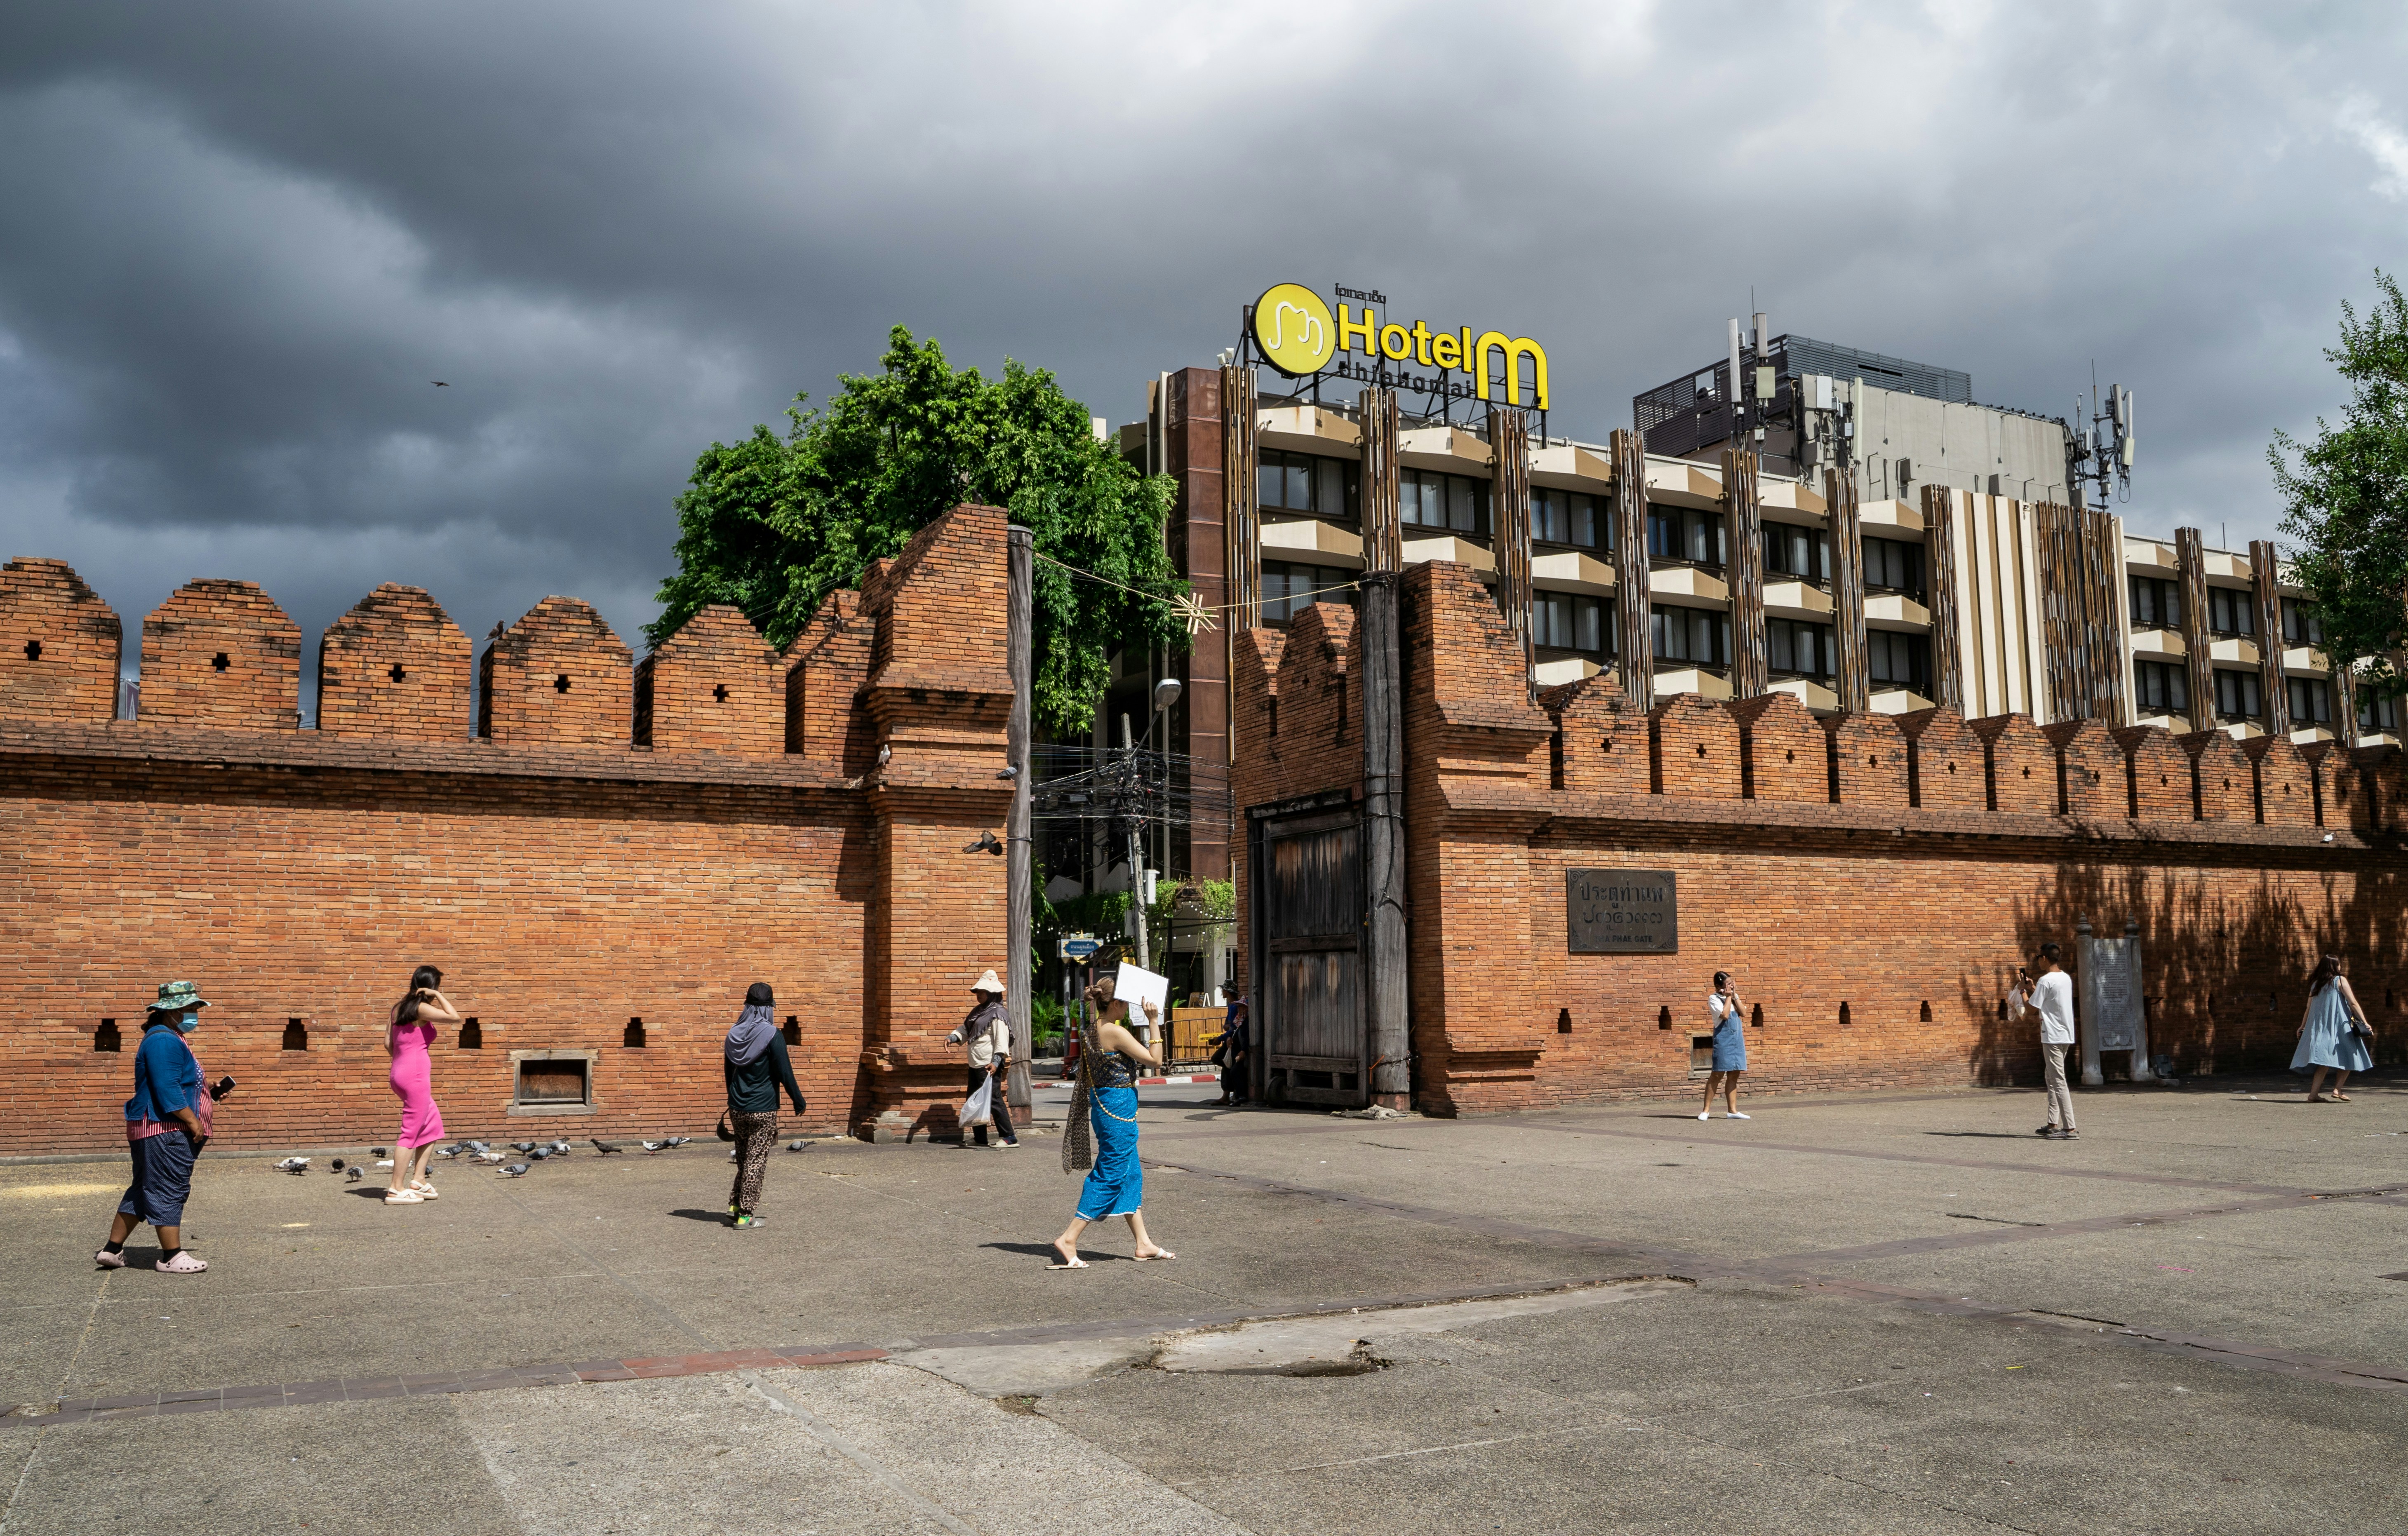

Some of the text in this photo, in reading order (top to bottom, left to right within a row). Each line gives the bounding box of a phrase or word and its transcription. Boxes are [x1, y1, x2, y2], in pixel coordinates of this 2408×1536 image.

[1337, 303, 1472, 373] Hotel
[1580, 881, 1663, 909] ประตูท่าแพ
